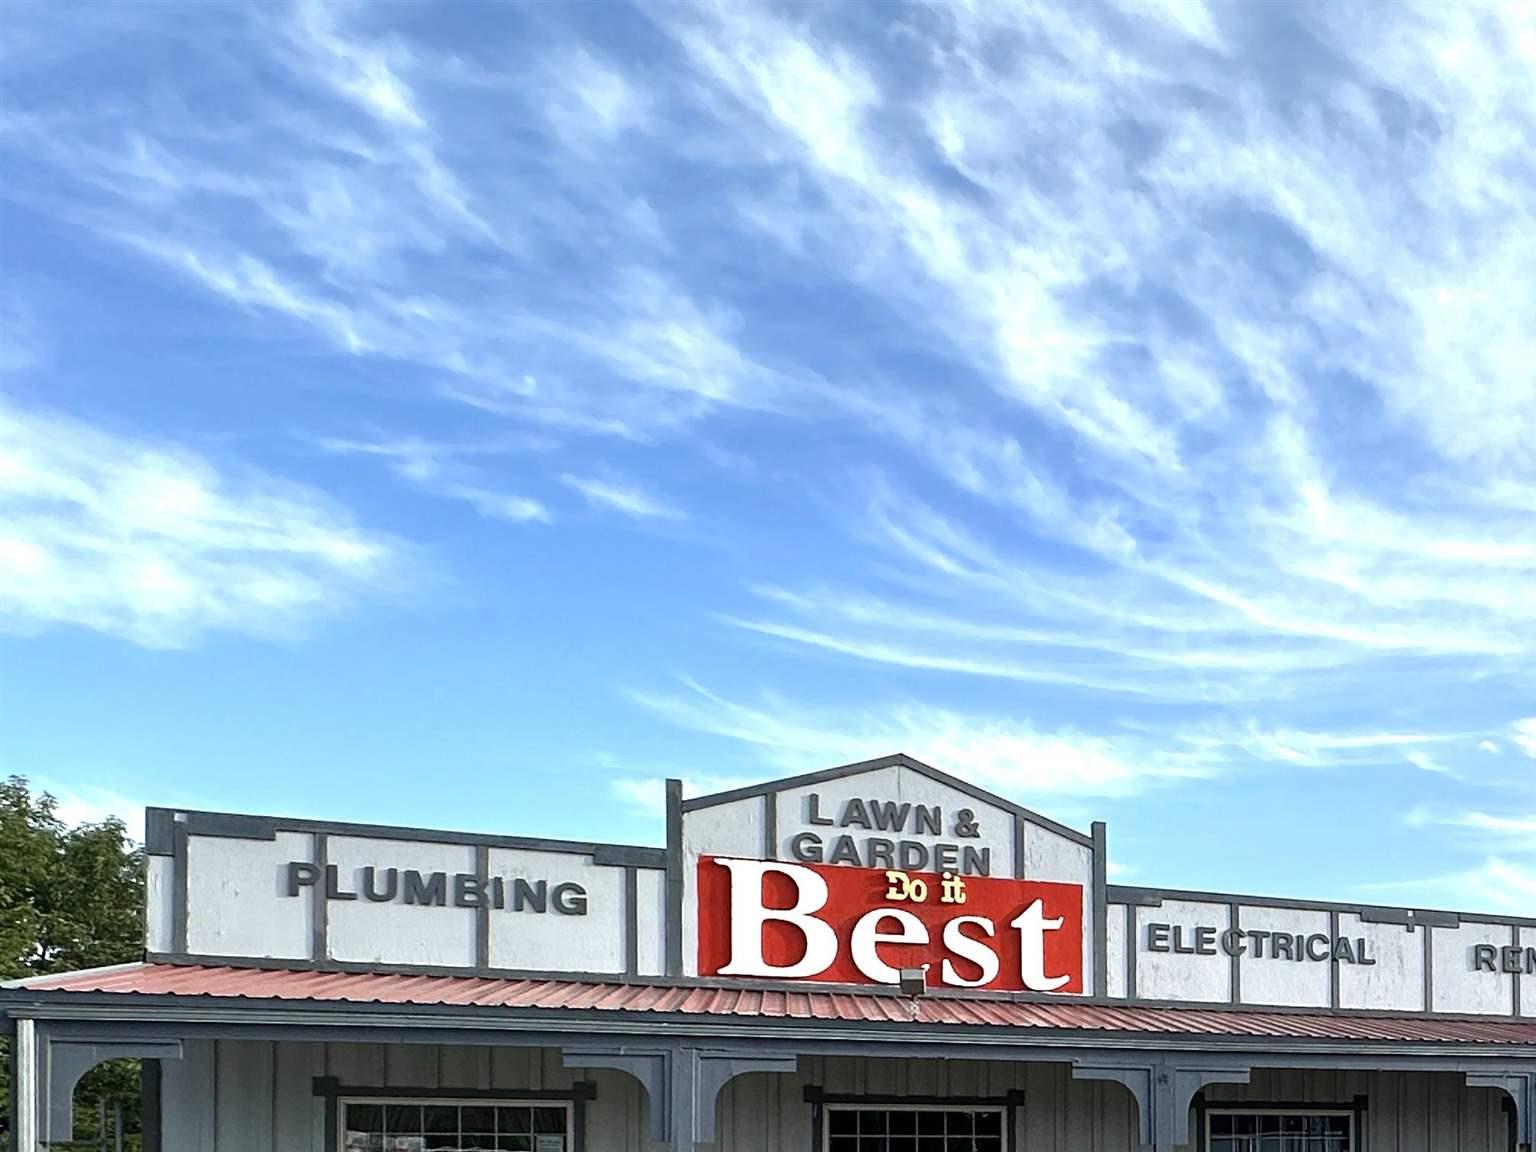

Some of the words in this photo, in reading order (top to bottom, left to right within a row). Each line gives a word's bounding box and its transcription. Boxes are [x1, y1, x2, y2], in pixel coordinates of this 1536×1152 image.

[808, 793, 942, 836] LAWN
[954, 807, 981, 839] &
[790, 832, 991, 876] GARDEN
[287, 861, 588, 916] PLUMBING
[885, 870, 928, 903] Do
[941, 872, 968, 904] it
[714, 857, 1072, 992] Best
[1148, 923, 1376, 966] ELECTRICAL
